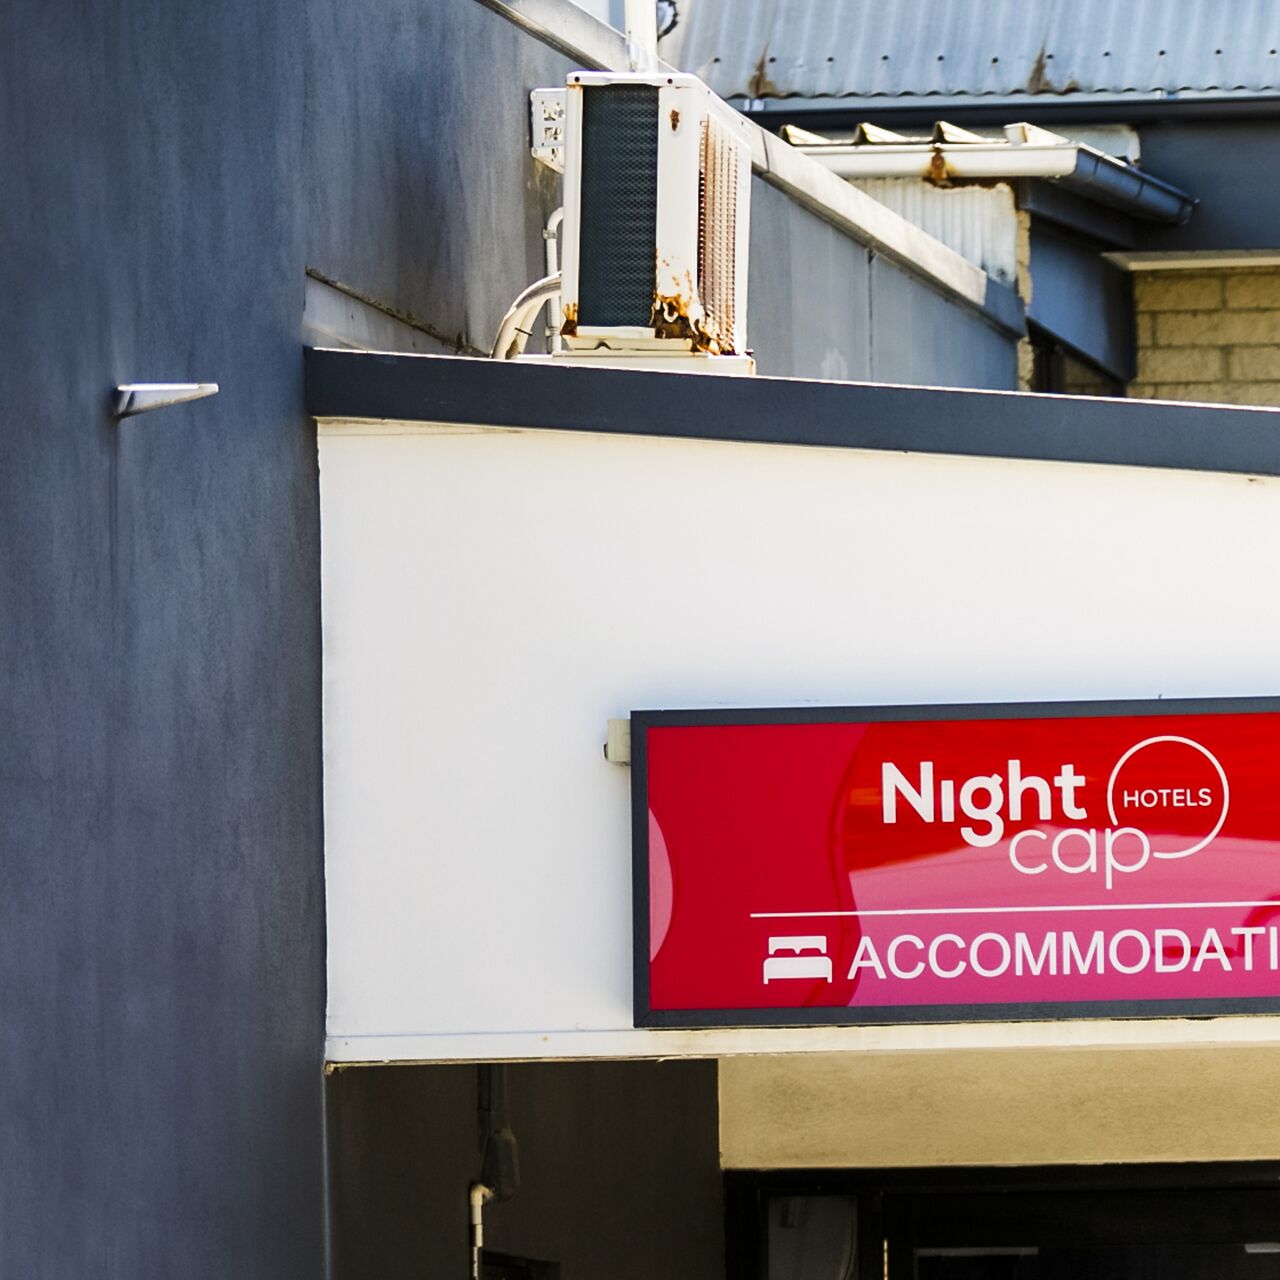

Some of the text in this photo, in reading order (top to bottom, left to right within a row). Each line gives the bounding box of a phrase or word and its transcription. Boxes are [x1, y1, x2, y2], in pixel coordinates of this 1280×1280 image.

[882, 759, 1088, 848] Night
[1123, 788, 1212, 808] HOTELS
[1009, 827, 1151, 890] cap
